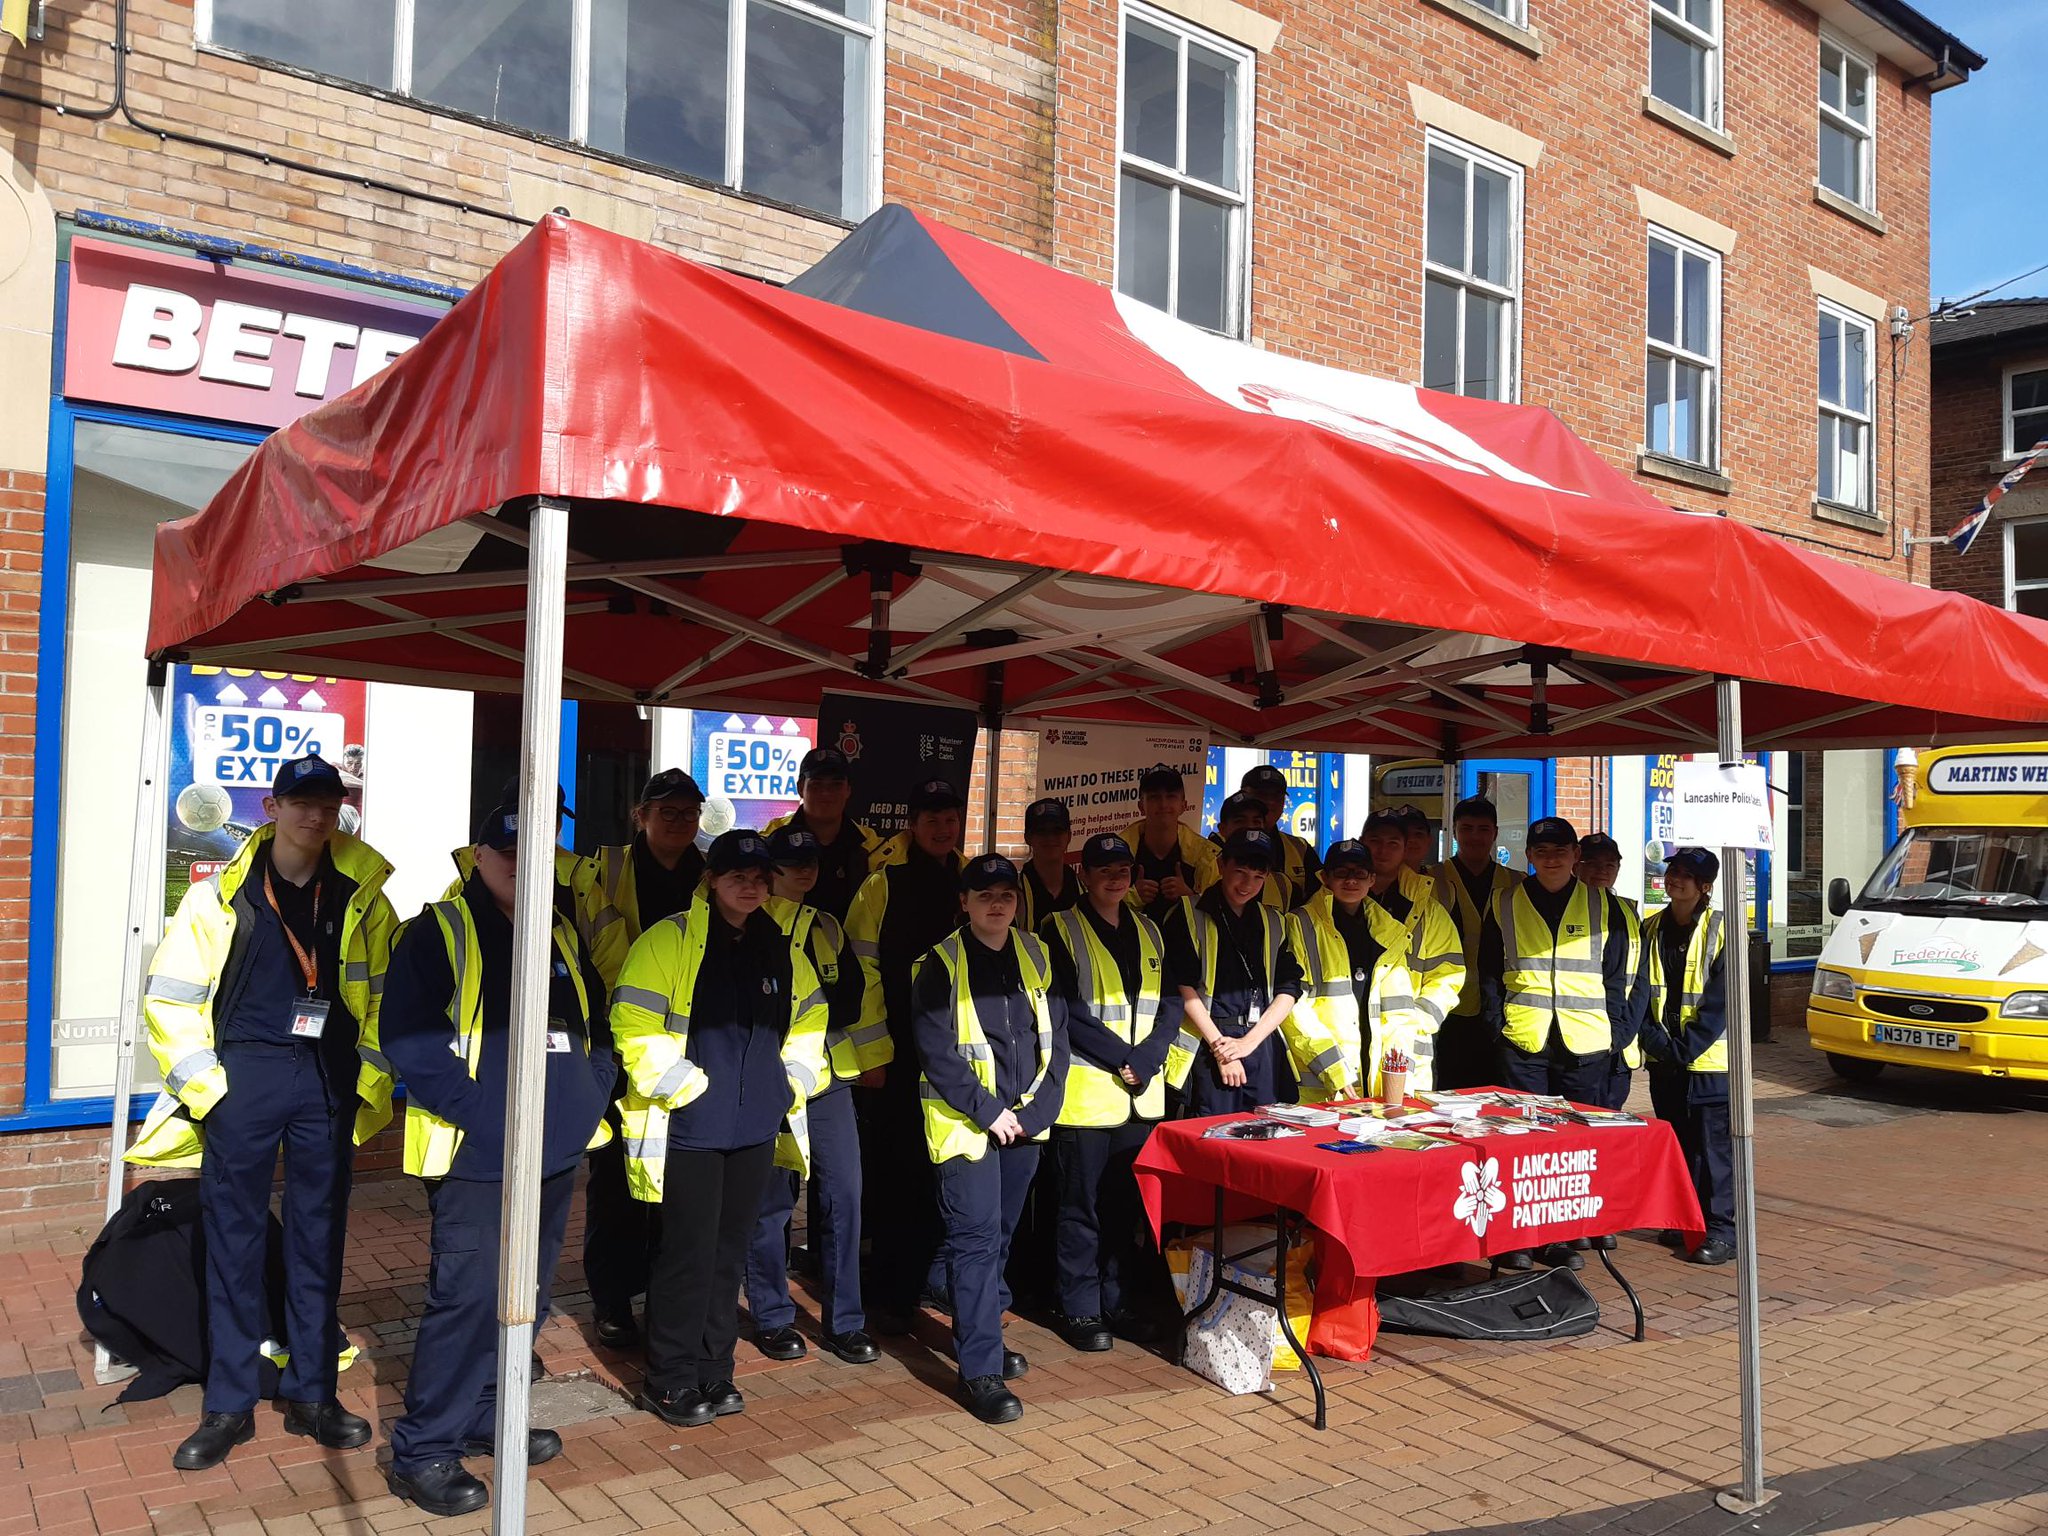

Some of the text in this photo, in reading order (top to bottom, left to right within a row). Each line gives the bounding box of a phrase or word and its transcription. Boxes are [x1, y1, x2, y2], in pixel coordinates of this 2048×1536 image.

[221, 714, 321, 755] 50%
[715, 738, 724, 769] UP TO
[727, 739, 797, 772] 50%
[926, 735, 935, 757] VPC
[724, 773, 798, 795] EXTRA
[1044, 774, 1079, 791] WHAT
[1081, 773, 1098, 786] DO
[1100, 768, 1134, 785] THESE
[1180, 763, 1199, 776] ALL
[1948, 766, 2018, 782] MARTINS
[870, 802, 892, 814] AGED
[1076, 793, 1089, 807] IN
[1091, 787, 1140, 805] COMMO
[1684, 791, 1729, 803] Lancashire
[881, 818, 892, 829] 18
[1088, 811, 1112, 824] helped
[1114, 809, 1132, 820] them
[1072, 827, 1085, 838] and
[195, 864, 212, 873] ON
[1893, 948, 1980, 964] Frederick's
[1884, 1026, 1956, 1048] N378 TEP
[1513, 1149, 1597, 1179] LANCASHIRE
[1512, 1173, 1591, 1203] VOLUNTEER
[1512, 1196, 1603, 1229] PARTNERSHIP
